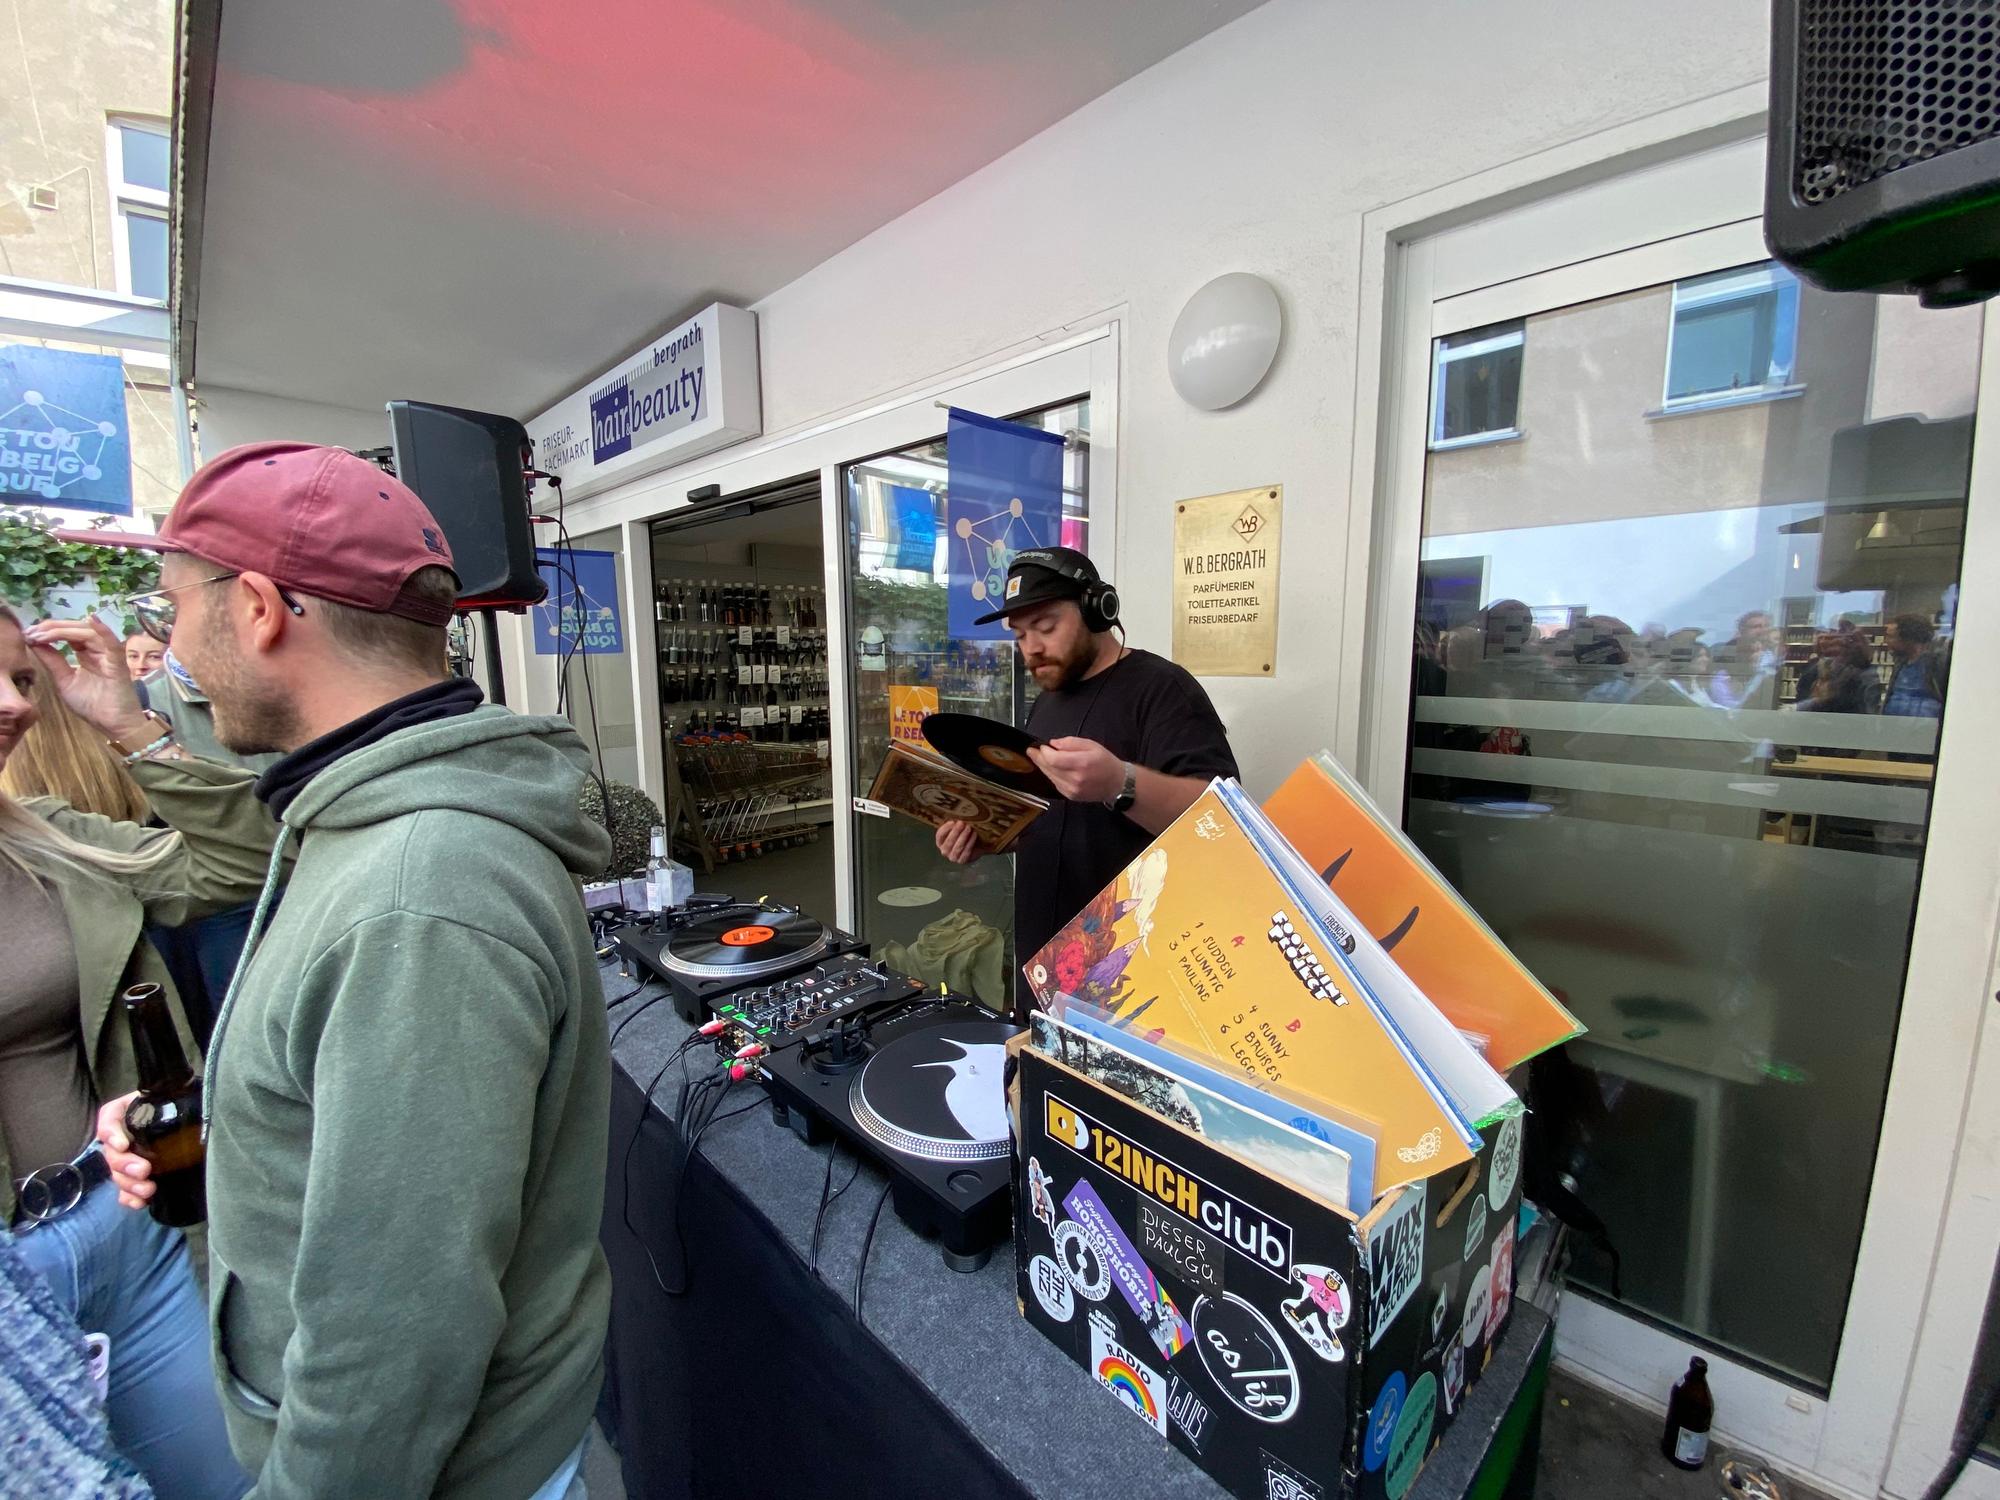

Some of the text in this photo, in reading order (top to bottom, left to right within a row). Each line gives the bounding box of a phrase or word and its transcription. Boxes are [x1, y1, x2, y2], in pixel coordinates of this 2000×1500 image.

[653, 321, 702, 367] bergrath
[16, 430, 81, 452] TOU
[543, 425, 574, 453] FRISEUR-
[544, 438, 590, 472] FACHMARKT
[1207, 548, 1266, 574] BERGRATH
[1193, 580, 1255, 594] PARFÜMERIEN
[1188, 596, 1260, 609] TOILETTEARTIKEL
[1188, 612, 1259, 625] FRISEURBEDARF
[903, 725, 925, 740] BEL
[1181, 931, 1191, 941] 2
[1324, 914, 1348, 940] FRENCH
[1168, 940, 1179, 951] 3
[1202, 935, 1237, 980] SUDDEN
[1271, 910, 1350, 1008] FOOTPRINT
[1267, 923, 1331, 1002] PROJECT
[1220, 1023, 1232, 1034] 6
[1233, 1013, 1245, 1024] 5
[1249, 1004, 1259, 1014] 4
[1259, 1022, 1291, 1060] SUNNY
[1084, 1198, 1149, 1292] Fußballfans gegen
[1142, 1206, 1207, 1261] DIESER
[1370, 1196, 1425, 1295] WAX
[1070, 1195, 1151, 1311] HOMOPHOBIE
[1379, 1245, 1420, 1328] RECORDS
[1106, 1343, 1151, 1385] RADIO
[1099, 1374, 1121, 1399] LOVE
[1134, 1403, 1159, 1429] LOVE
